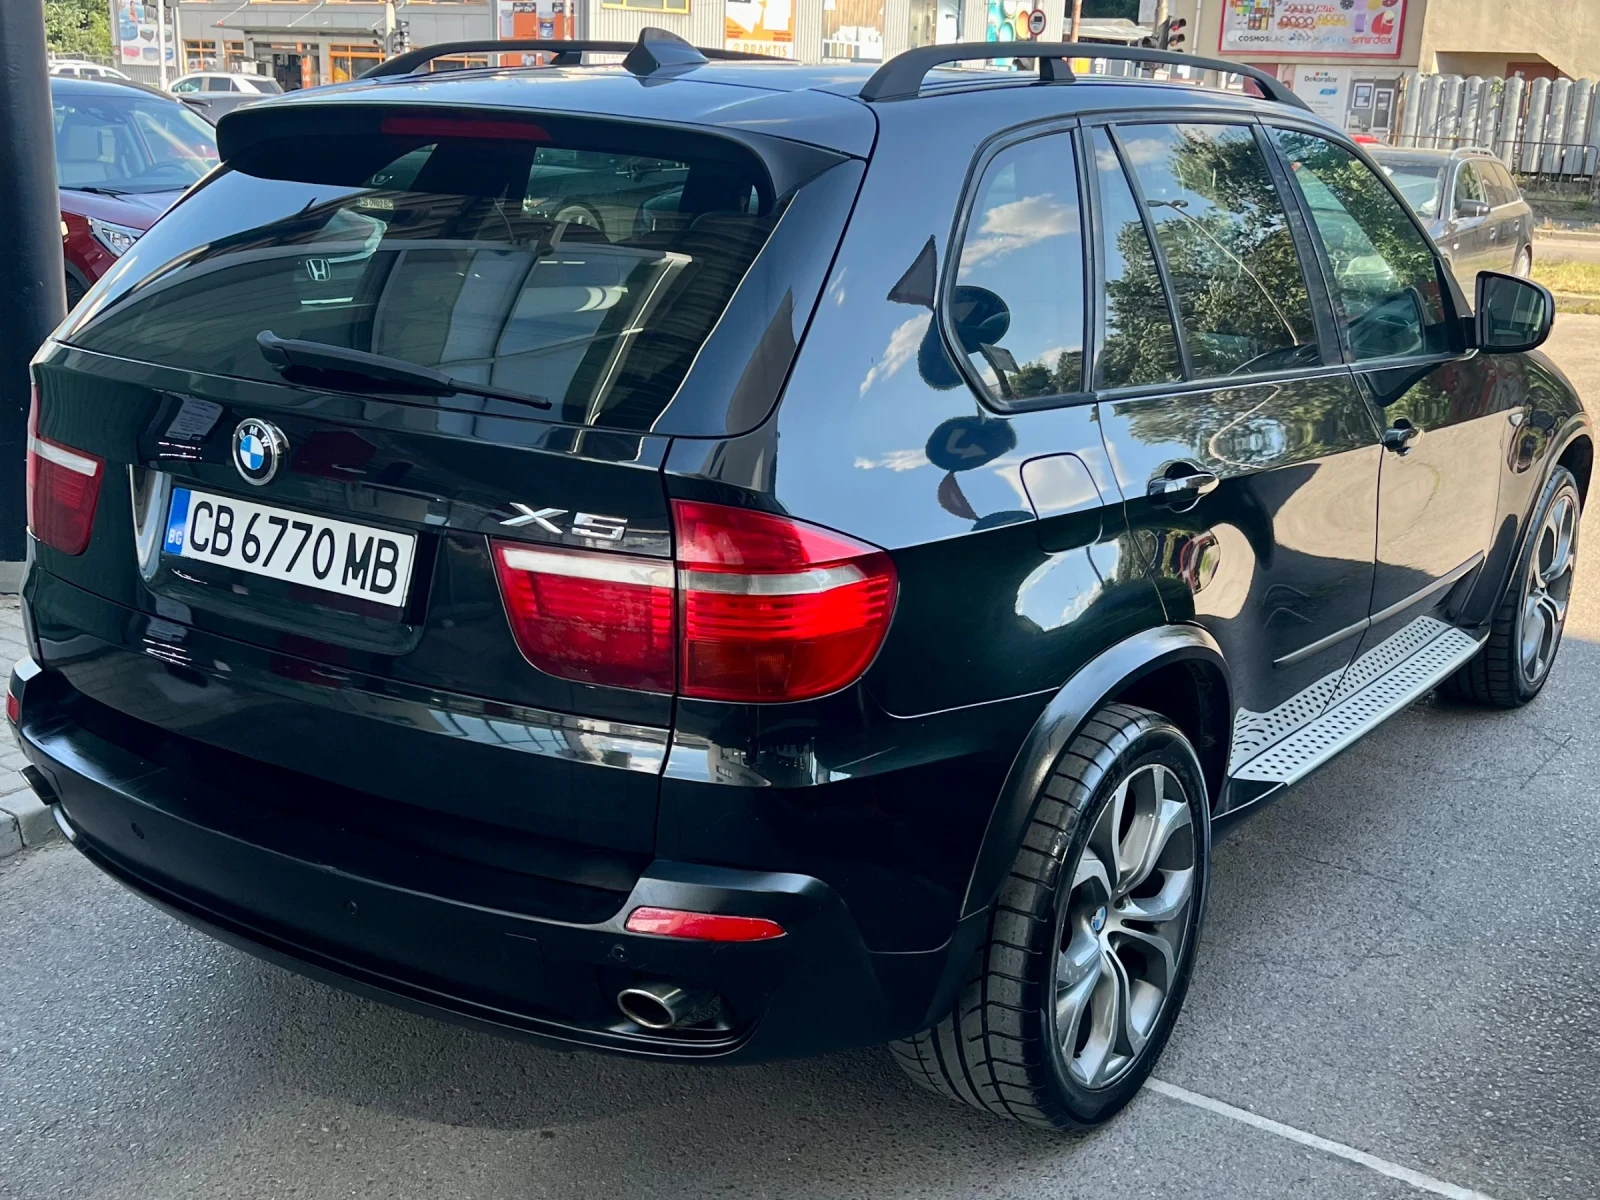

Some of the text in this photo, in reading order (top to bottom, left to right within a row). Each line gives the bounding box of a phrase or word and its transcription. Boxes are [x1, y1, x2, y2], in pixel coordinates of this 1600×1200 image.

[1238, 35, 1284, 43] COSMOSLAC
[1351, 34, 1392, 45] smirdex
[743, 43, 787, 57] PRAKTIS
[1304, 75, 1338, 83] Dekorator
[238, 425, 271, 448] BMW
[500, 502, 628, 541] X5
[167, 527, 184, 546] BG
[189, 501, 400, 595] CB 6770 MB
